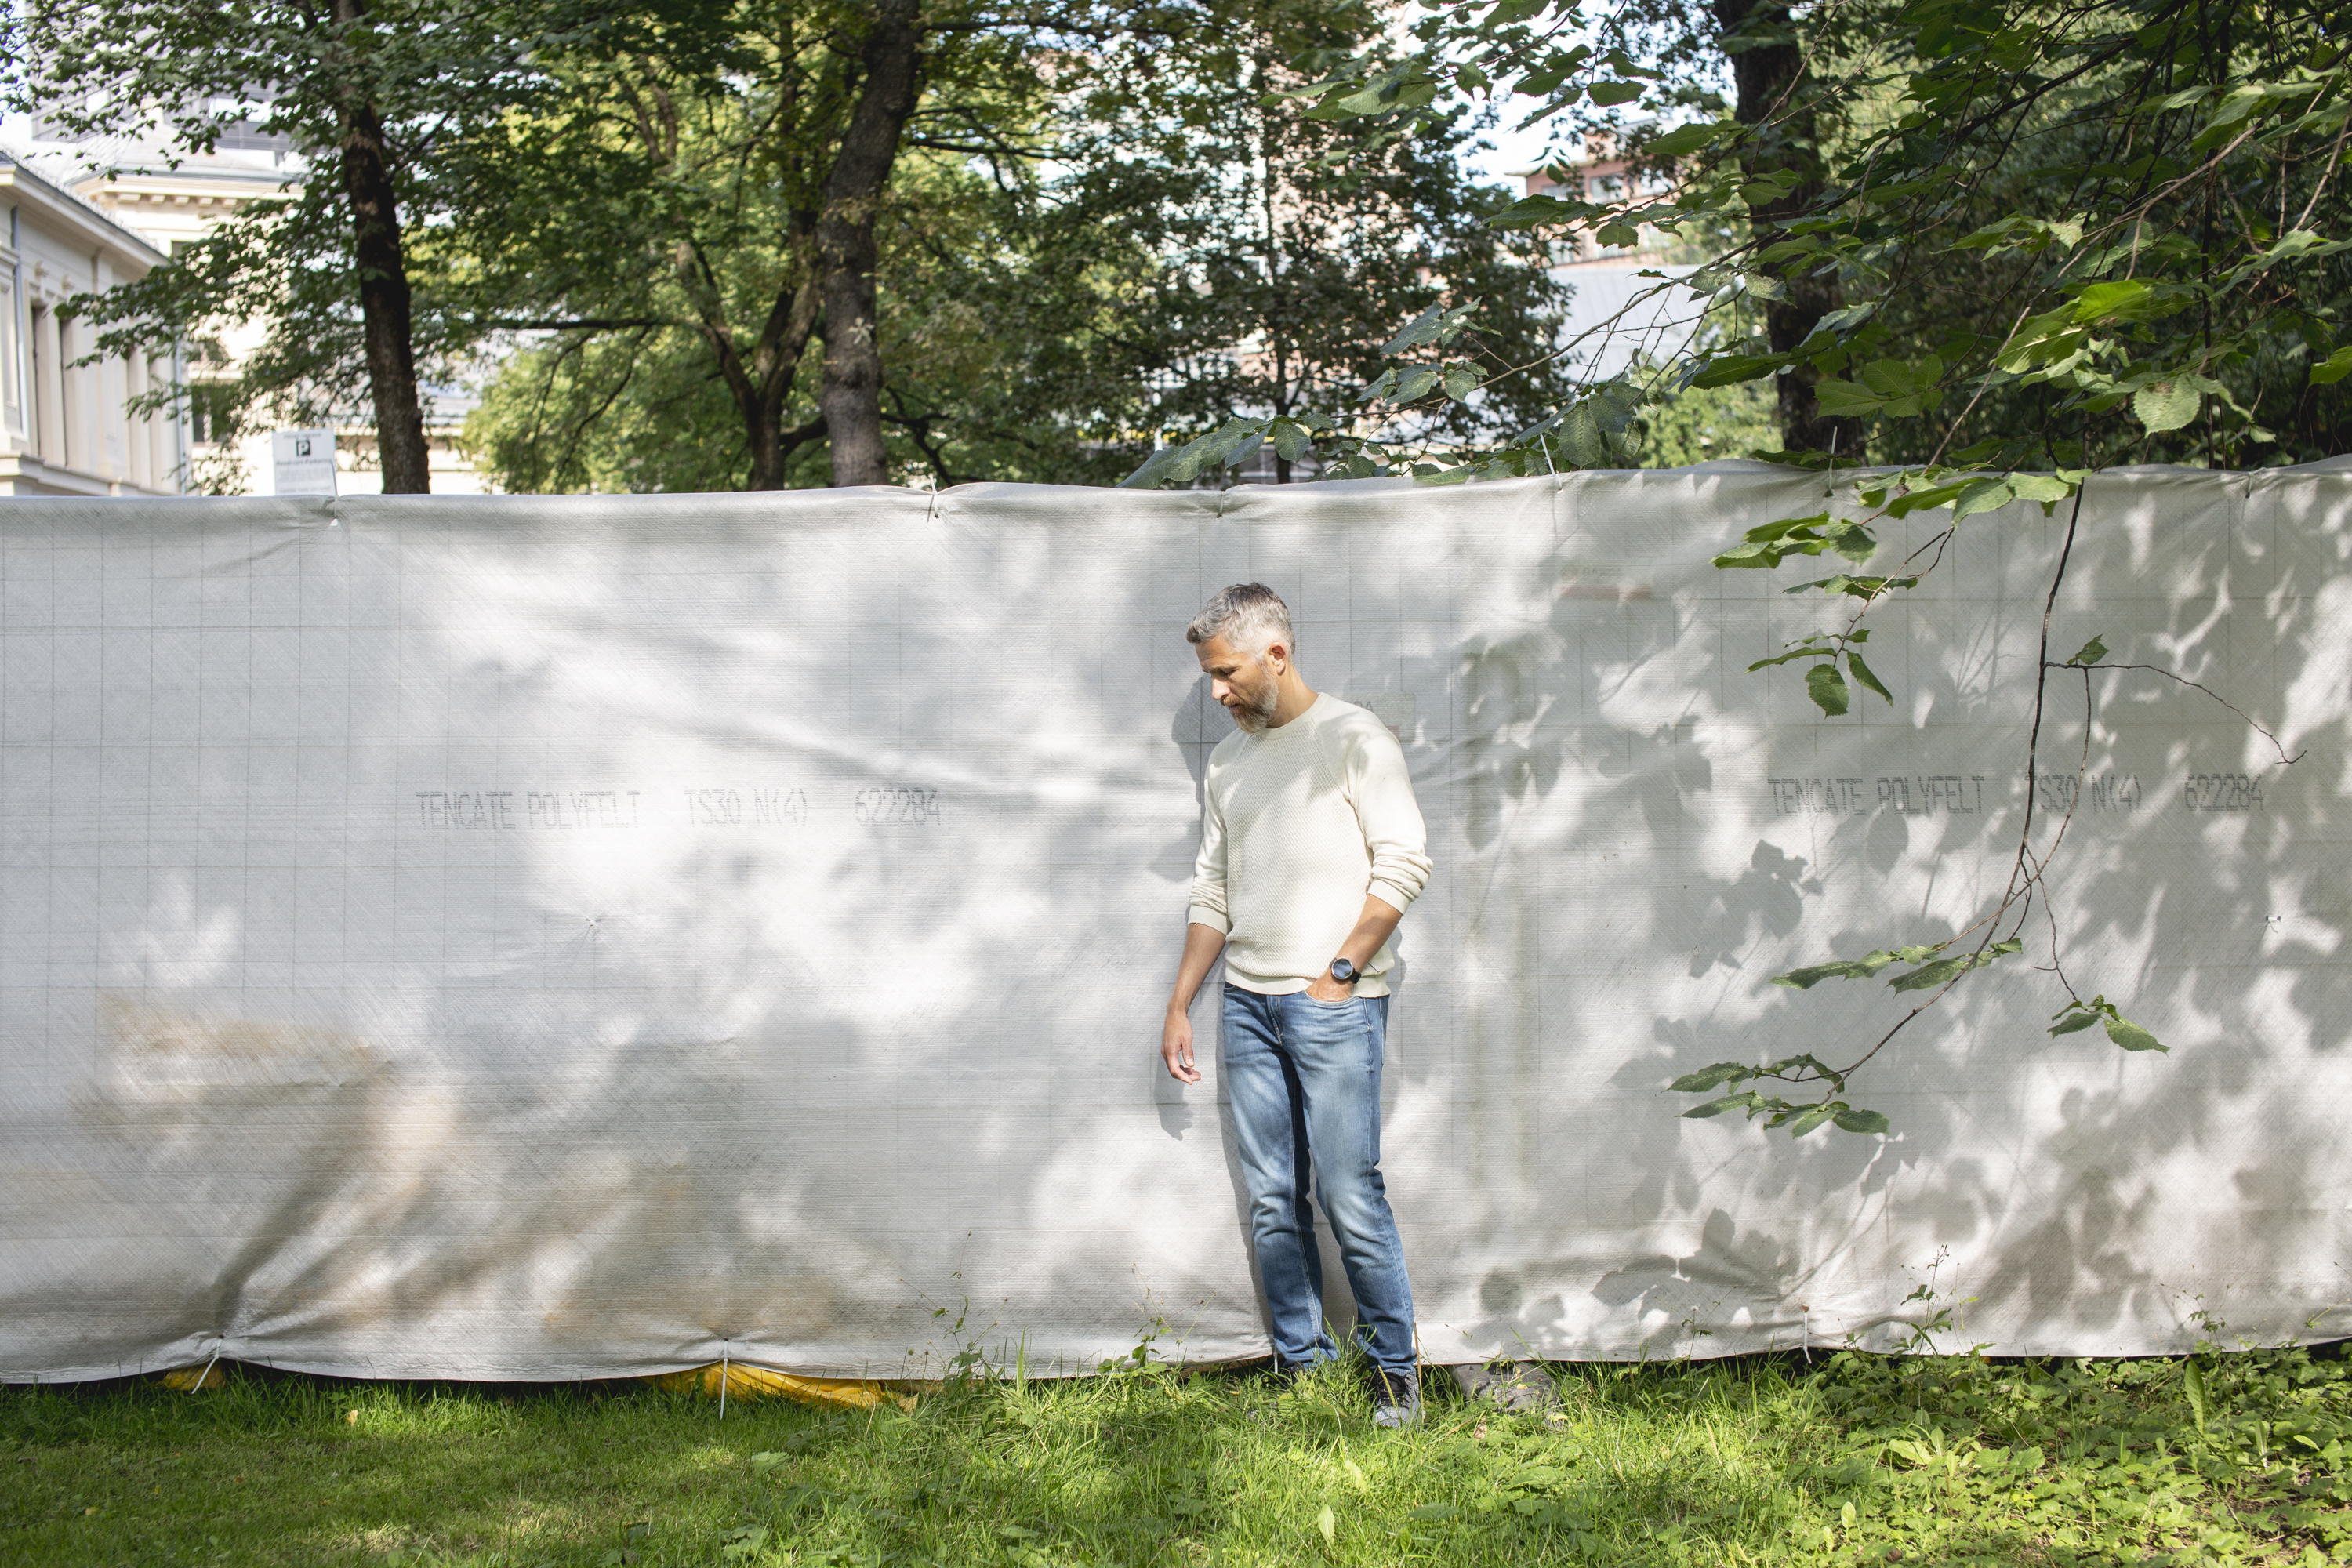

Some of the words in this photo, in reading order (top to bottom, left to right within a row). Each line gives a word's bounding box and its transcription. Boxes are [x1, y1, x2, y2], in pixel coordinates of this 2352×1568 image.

[297, 440, 310, 456] P
[416, 791, 515, 829] TENCATE
[528, 790, 641, 829] POLYFELT
[684, 789, 741, 827] TS30
[754, 789, 808, 826] N(4)
[855, 788, 940, 826] 622284
[1767, 778, 1866, 816] TENCATE
[1877, 775, 1984, 815] POLYFELT
[2092, 774, 2141, 812] N(4)
[2184, 773, 2263, 811] 622284
